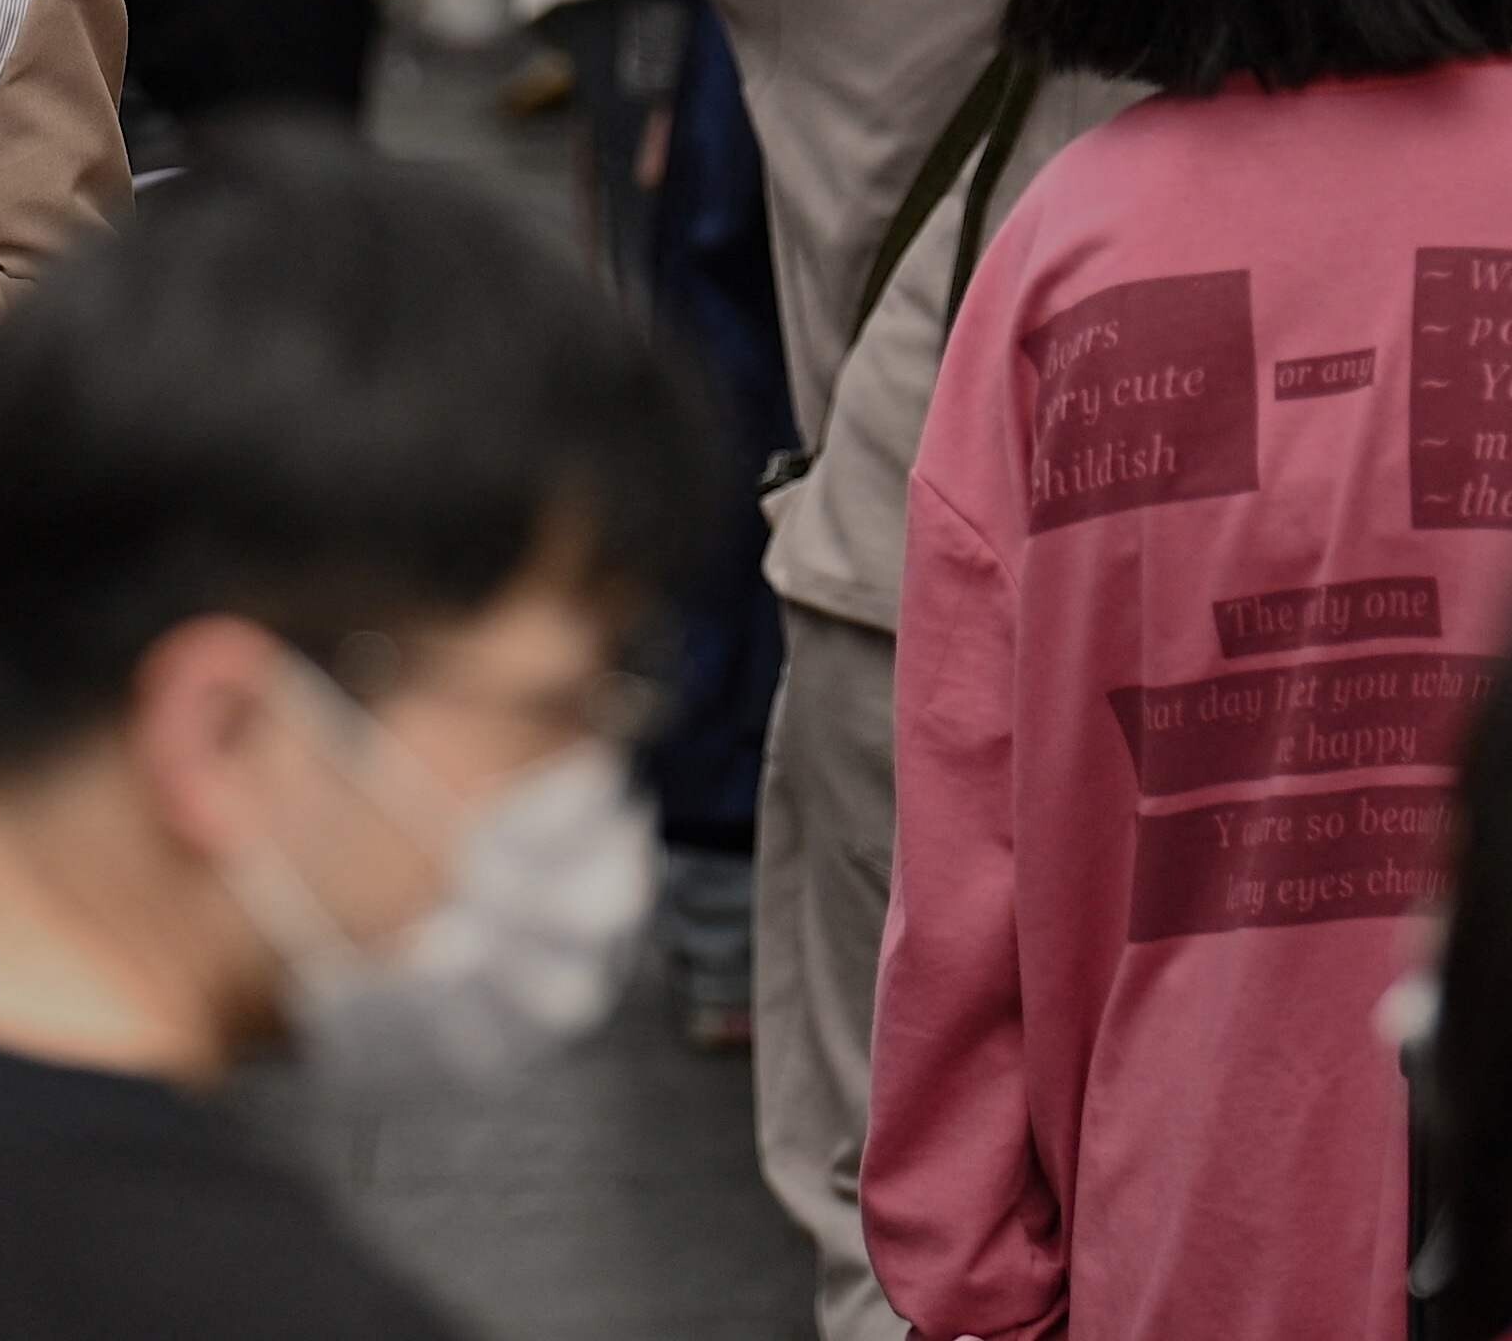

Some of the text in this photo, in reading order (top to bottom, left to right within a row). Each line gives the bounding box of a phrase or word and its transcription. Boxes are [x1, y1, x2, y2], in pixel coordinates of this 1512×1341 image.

[1112, 364, 1205, 409] cute
[1278, 356, 1373, 390] or any
[1225, 597, 1294, 639] The
[1362, 586, 1428, 620] one
[1198, 683, 1263, 725] day
[1332, 672, 1399, 713] you
[1306, 724, 1417, 767] happy
[1306, 812, 1345, 843] so
[1276, 872, 1354, 914] eyes
